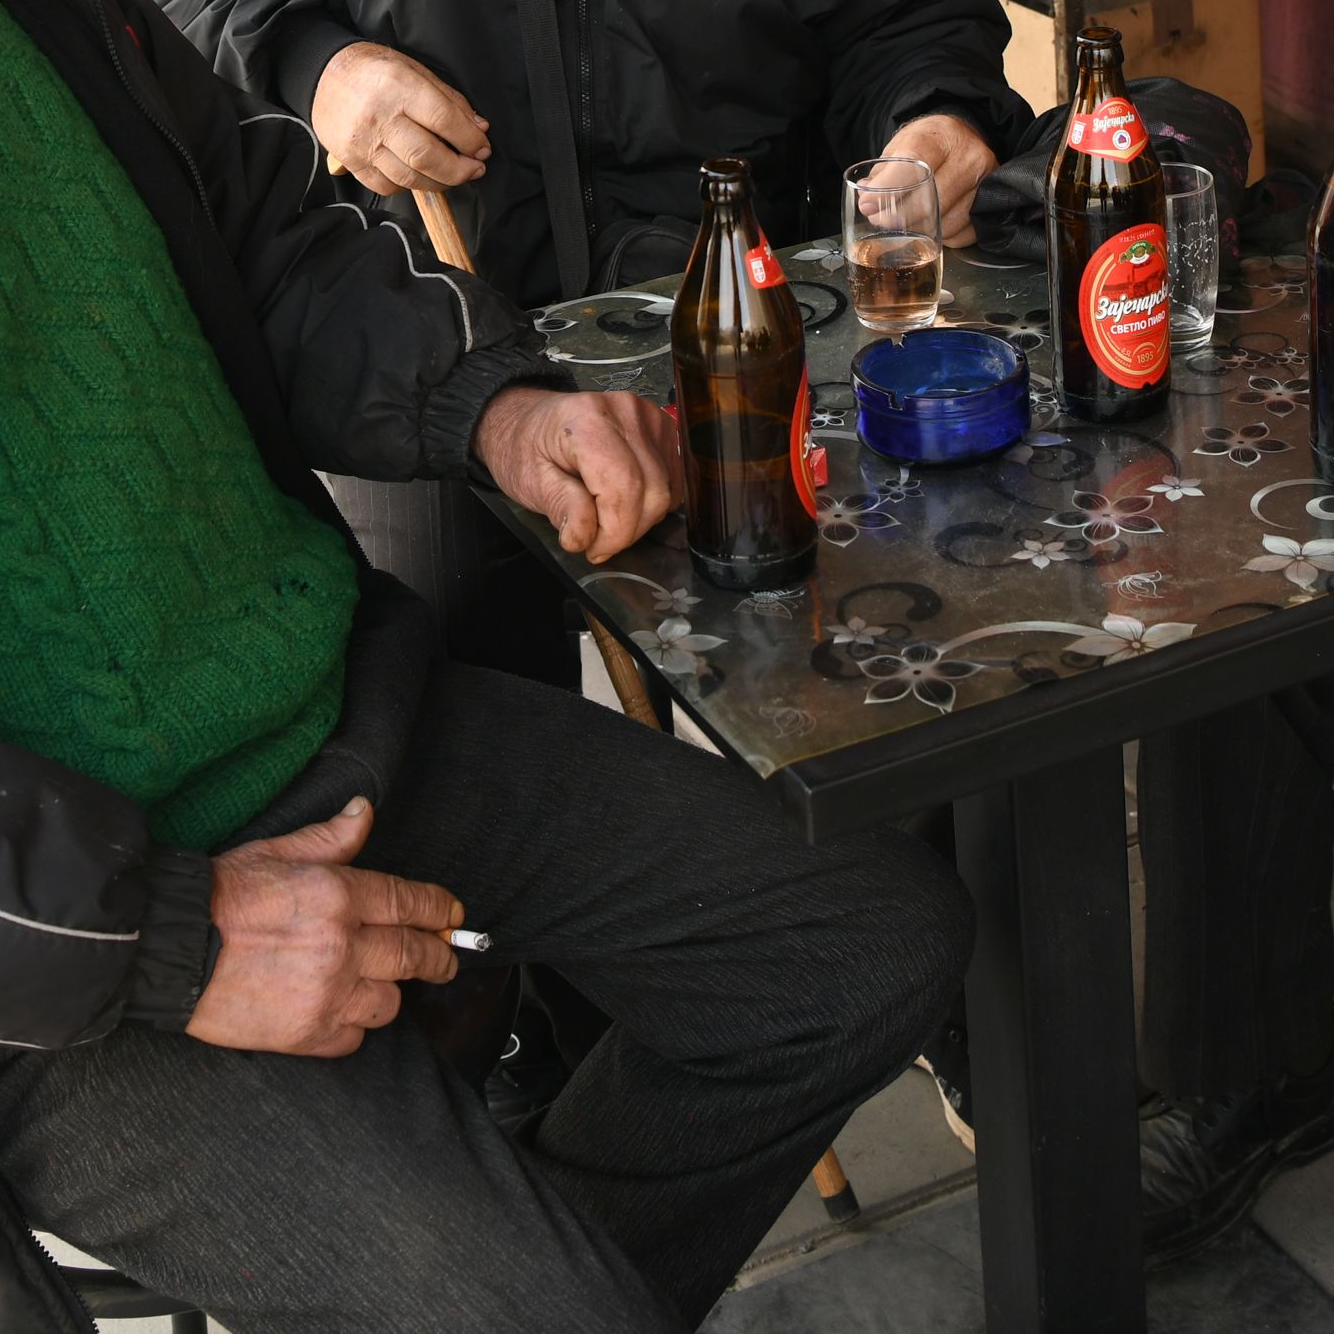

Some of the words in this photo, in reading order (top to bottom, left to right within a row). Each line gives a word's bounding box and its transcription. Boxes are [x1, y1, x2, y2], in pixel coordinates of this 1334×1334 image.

[1108, 106, 1123, 115] 1895
[1110, 320, 1148, 335] СВЕТЛО
[1148, 310, 1166, 327] ПИВО
[1137, 351, 1154, 364] 1895
